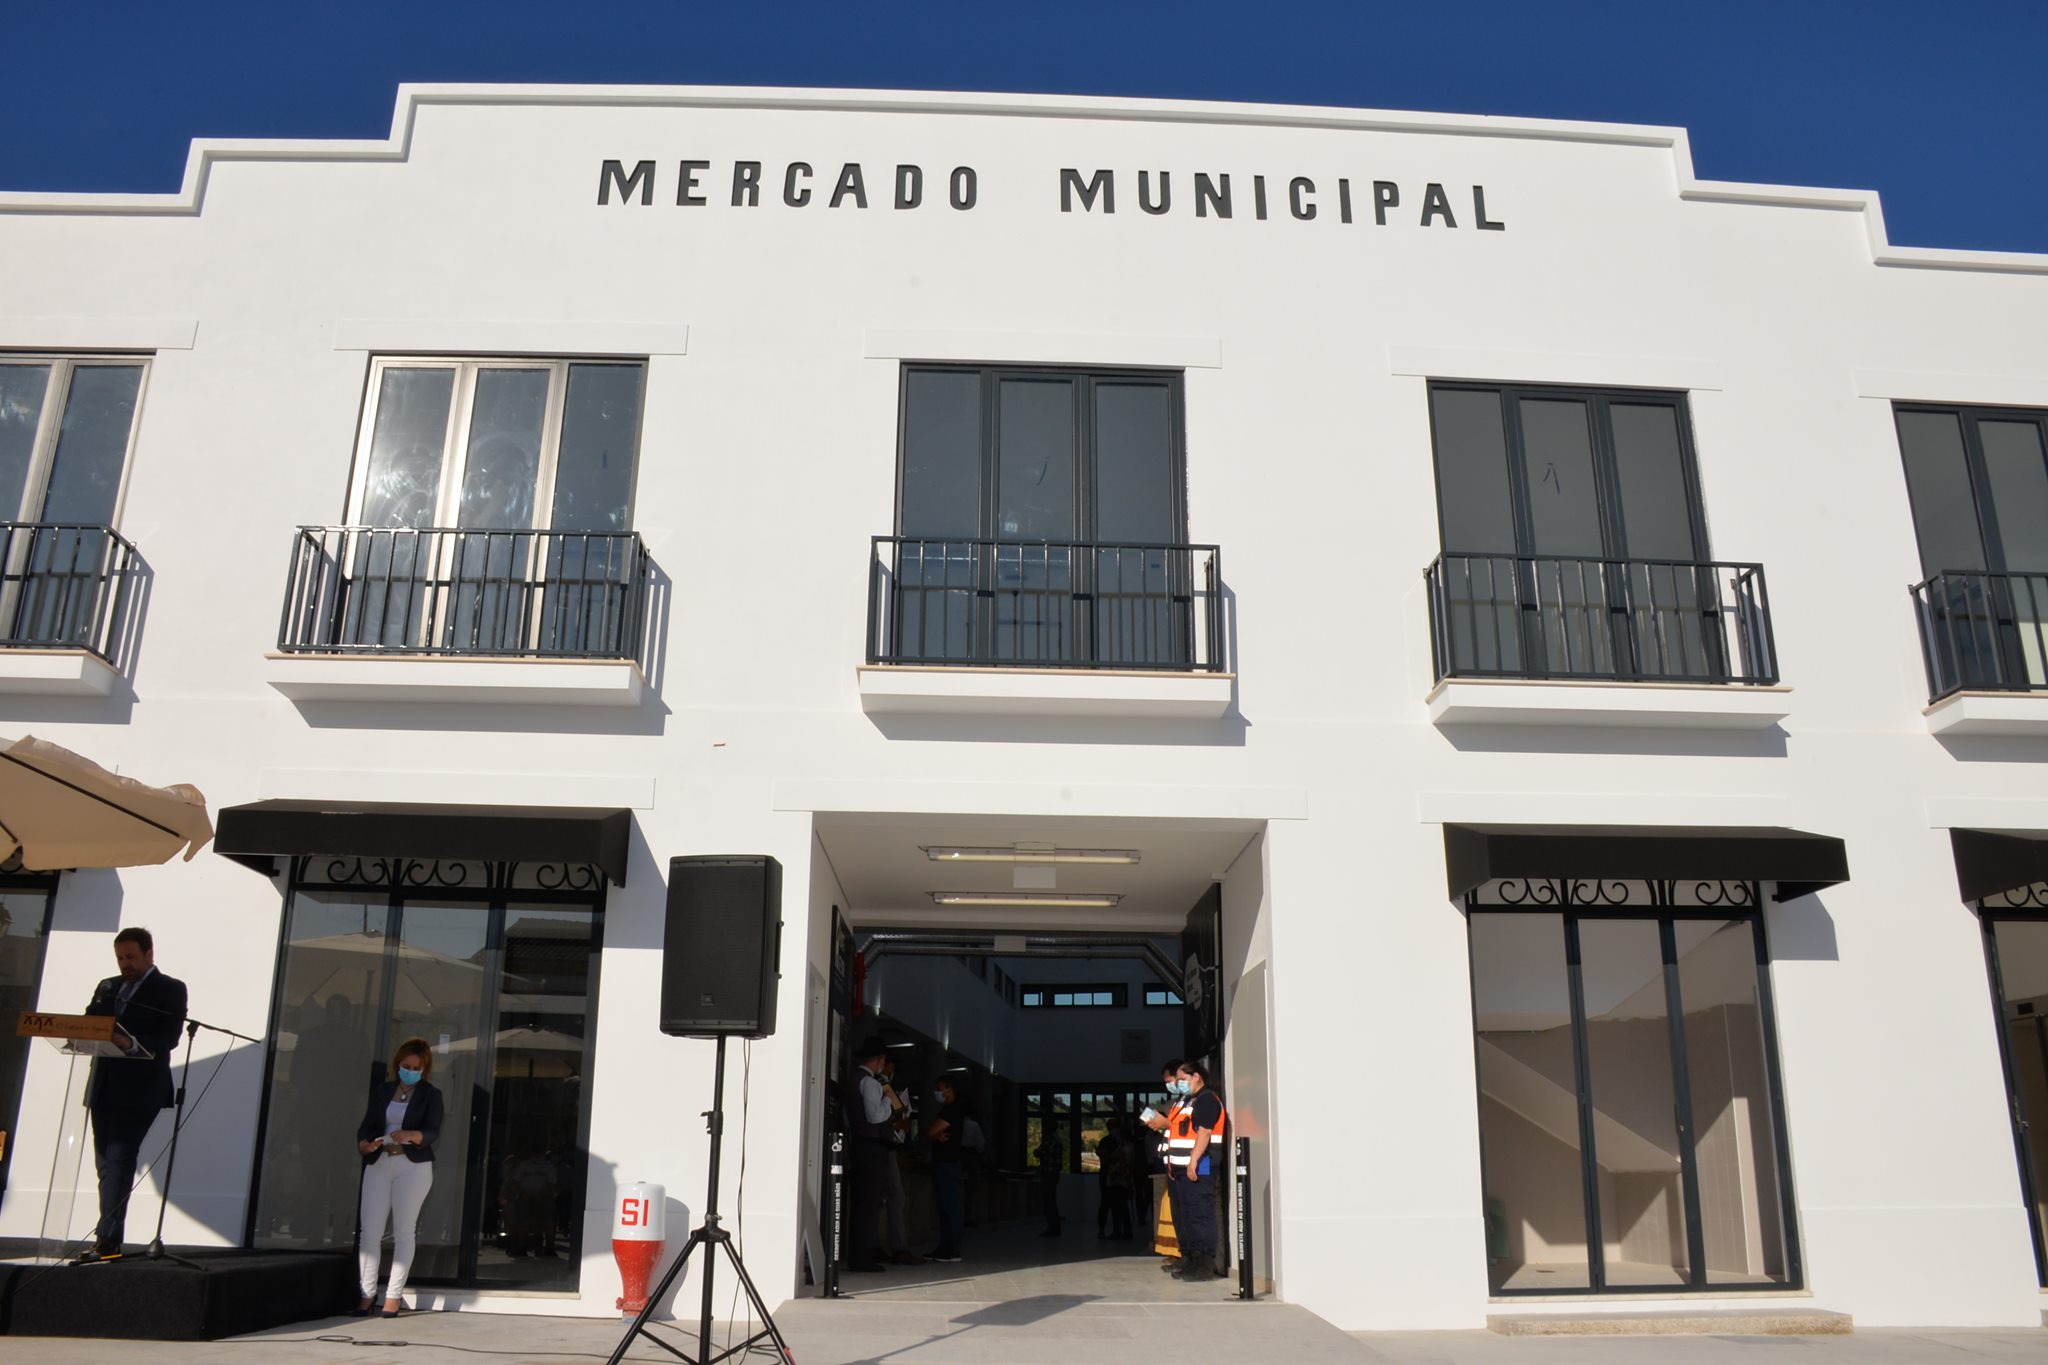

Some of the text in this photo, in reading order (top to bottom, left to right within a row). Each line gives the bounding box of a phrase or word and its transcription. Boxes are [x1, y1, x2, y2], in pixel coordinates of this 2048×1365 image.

[597, 159, 1505, 231] MERCADO MUNICIPAL
[621, 1198, 649, 1227] SI
